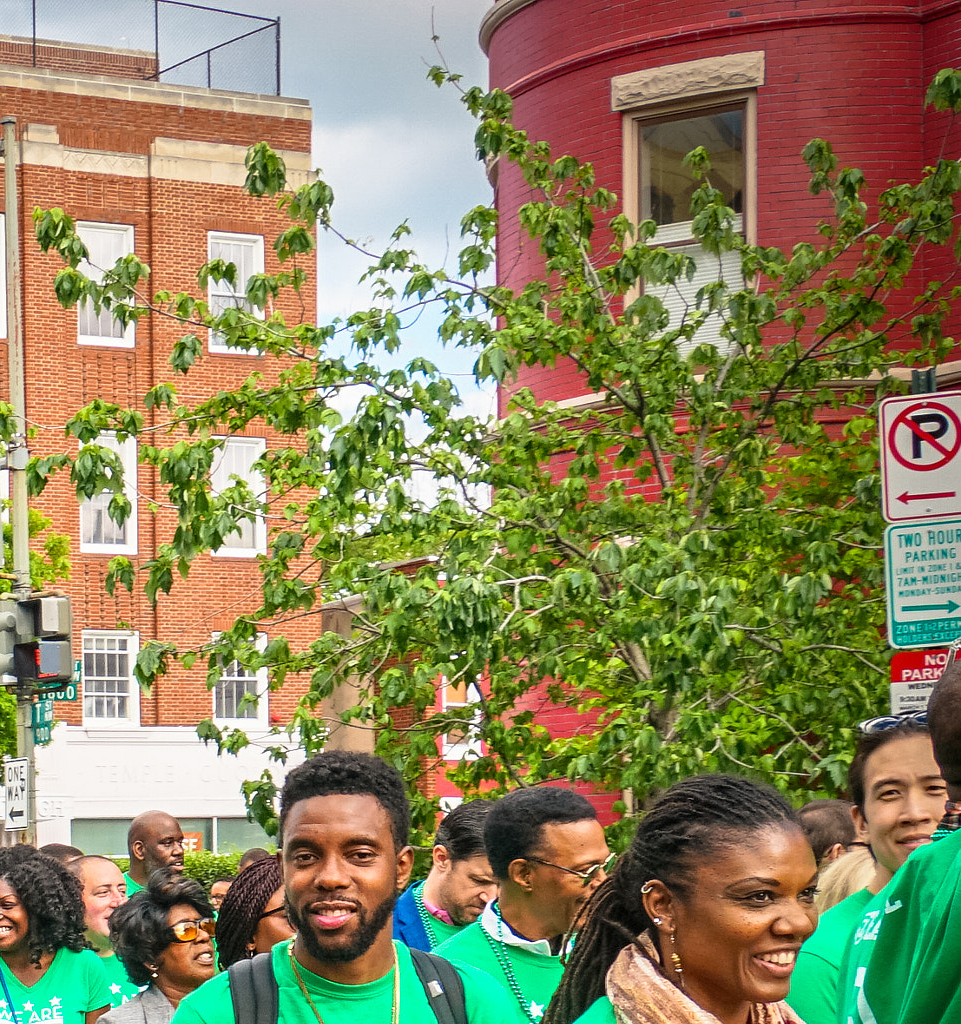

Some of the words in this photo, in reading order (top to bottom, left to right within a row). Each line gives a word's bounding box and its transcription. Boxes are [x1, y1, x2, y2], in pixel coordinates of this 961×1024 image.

[897, 532, 922, 548] TWO
[927, 528, 961, 546] HOUR
[905, 547, 957, 563] PARKING
[896, 624, 923, 635] ZONE
[924, 654, 948, 667] NO
[8, 765, 25, 783] ONE
[95, 765, 175, 783] TEMPLE
[8, 786, 26, 801] WAY
[28, 1005, 64, 1024] ARE
